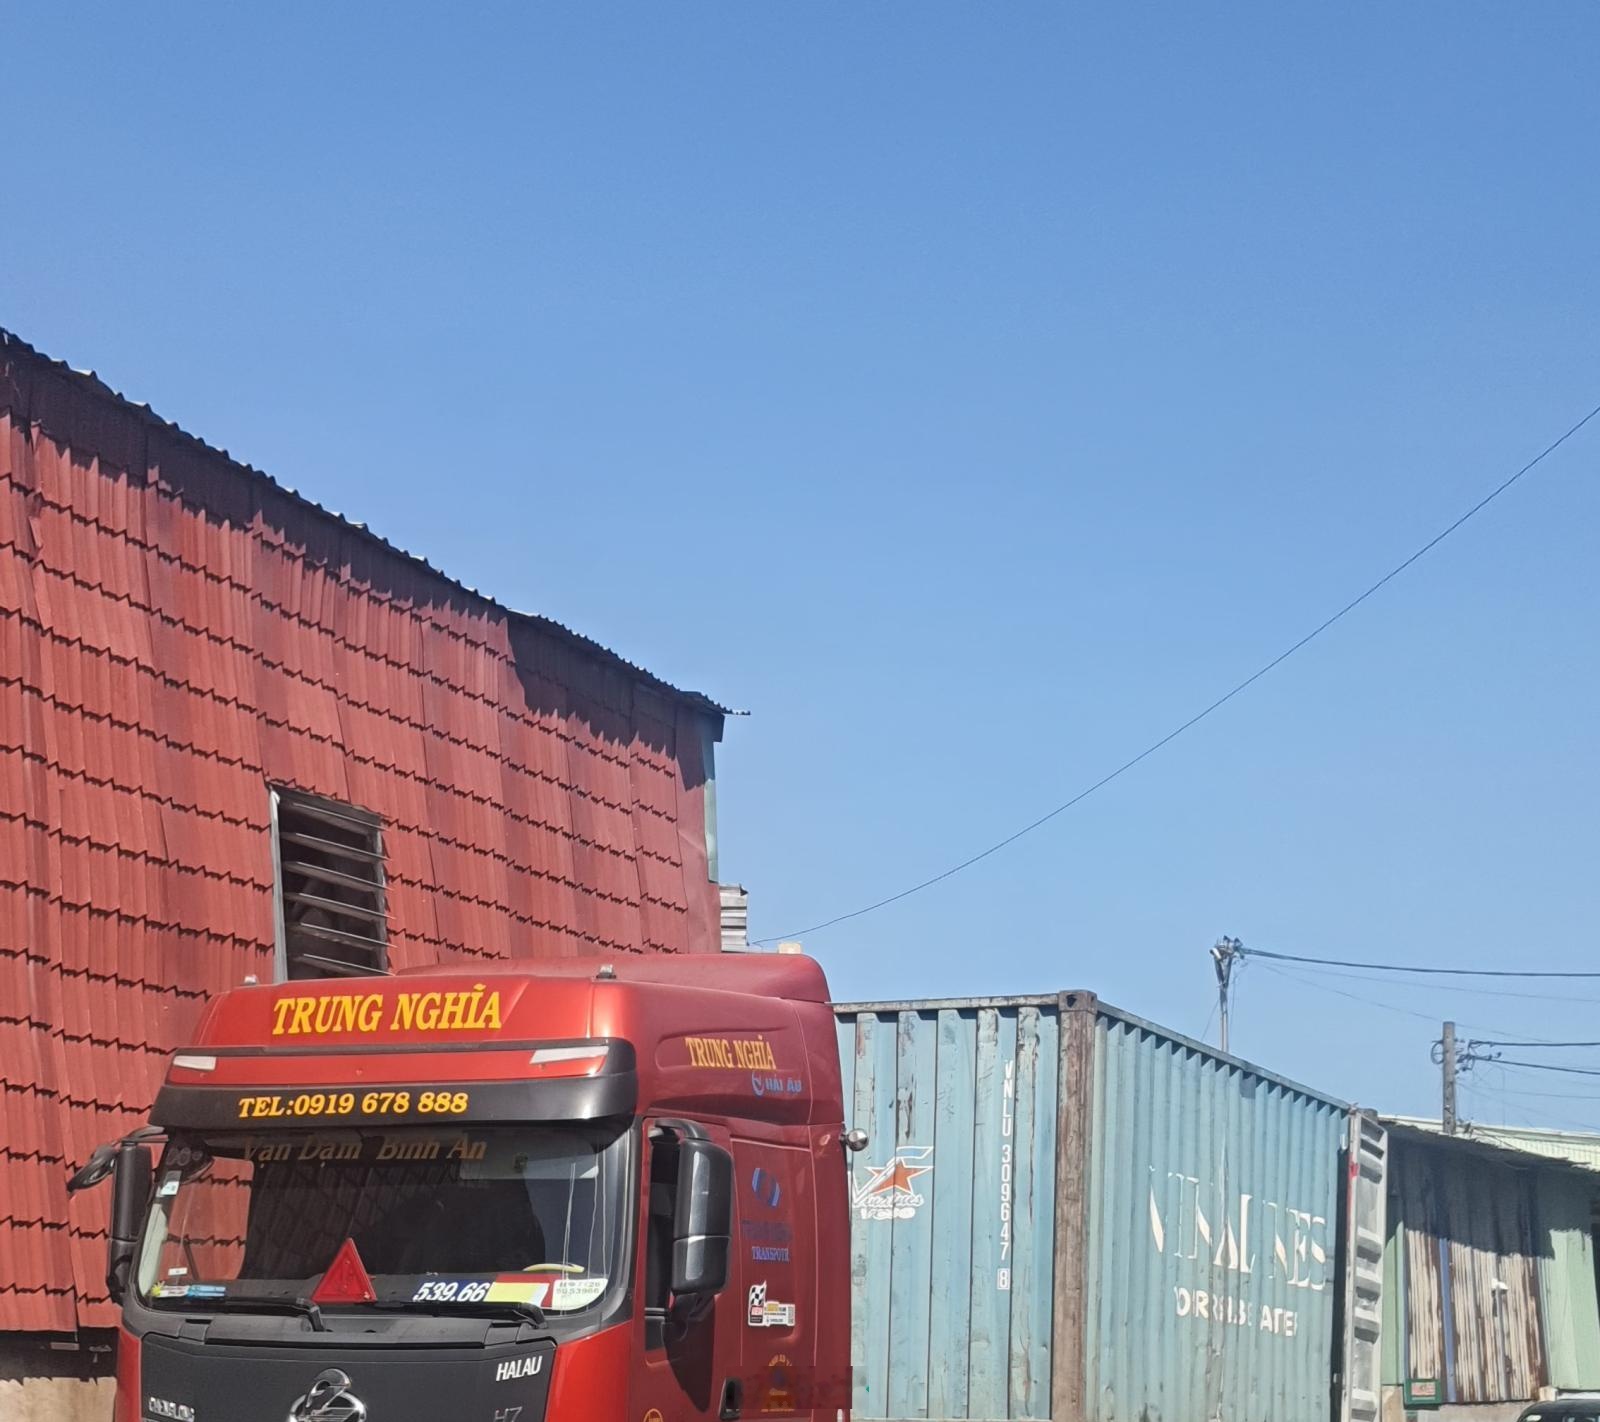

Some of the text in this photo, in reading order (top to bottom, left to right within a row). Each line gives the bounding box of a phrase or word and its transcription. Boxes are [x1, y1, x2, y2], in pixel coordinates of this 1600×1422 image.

[272, 994, 384, 1035] TRUNG
[684, 1036, 735, 1069] TRUNG
[361, 1092, 410, 1114] 678
[417, 1092, 468, 1113] 888
[412, 1281, 491, 1302] 539.66
